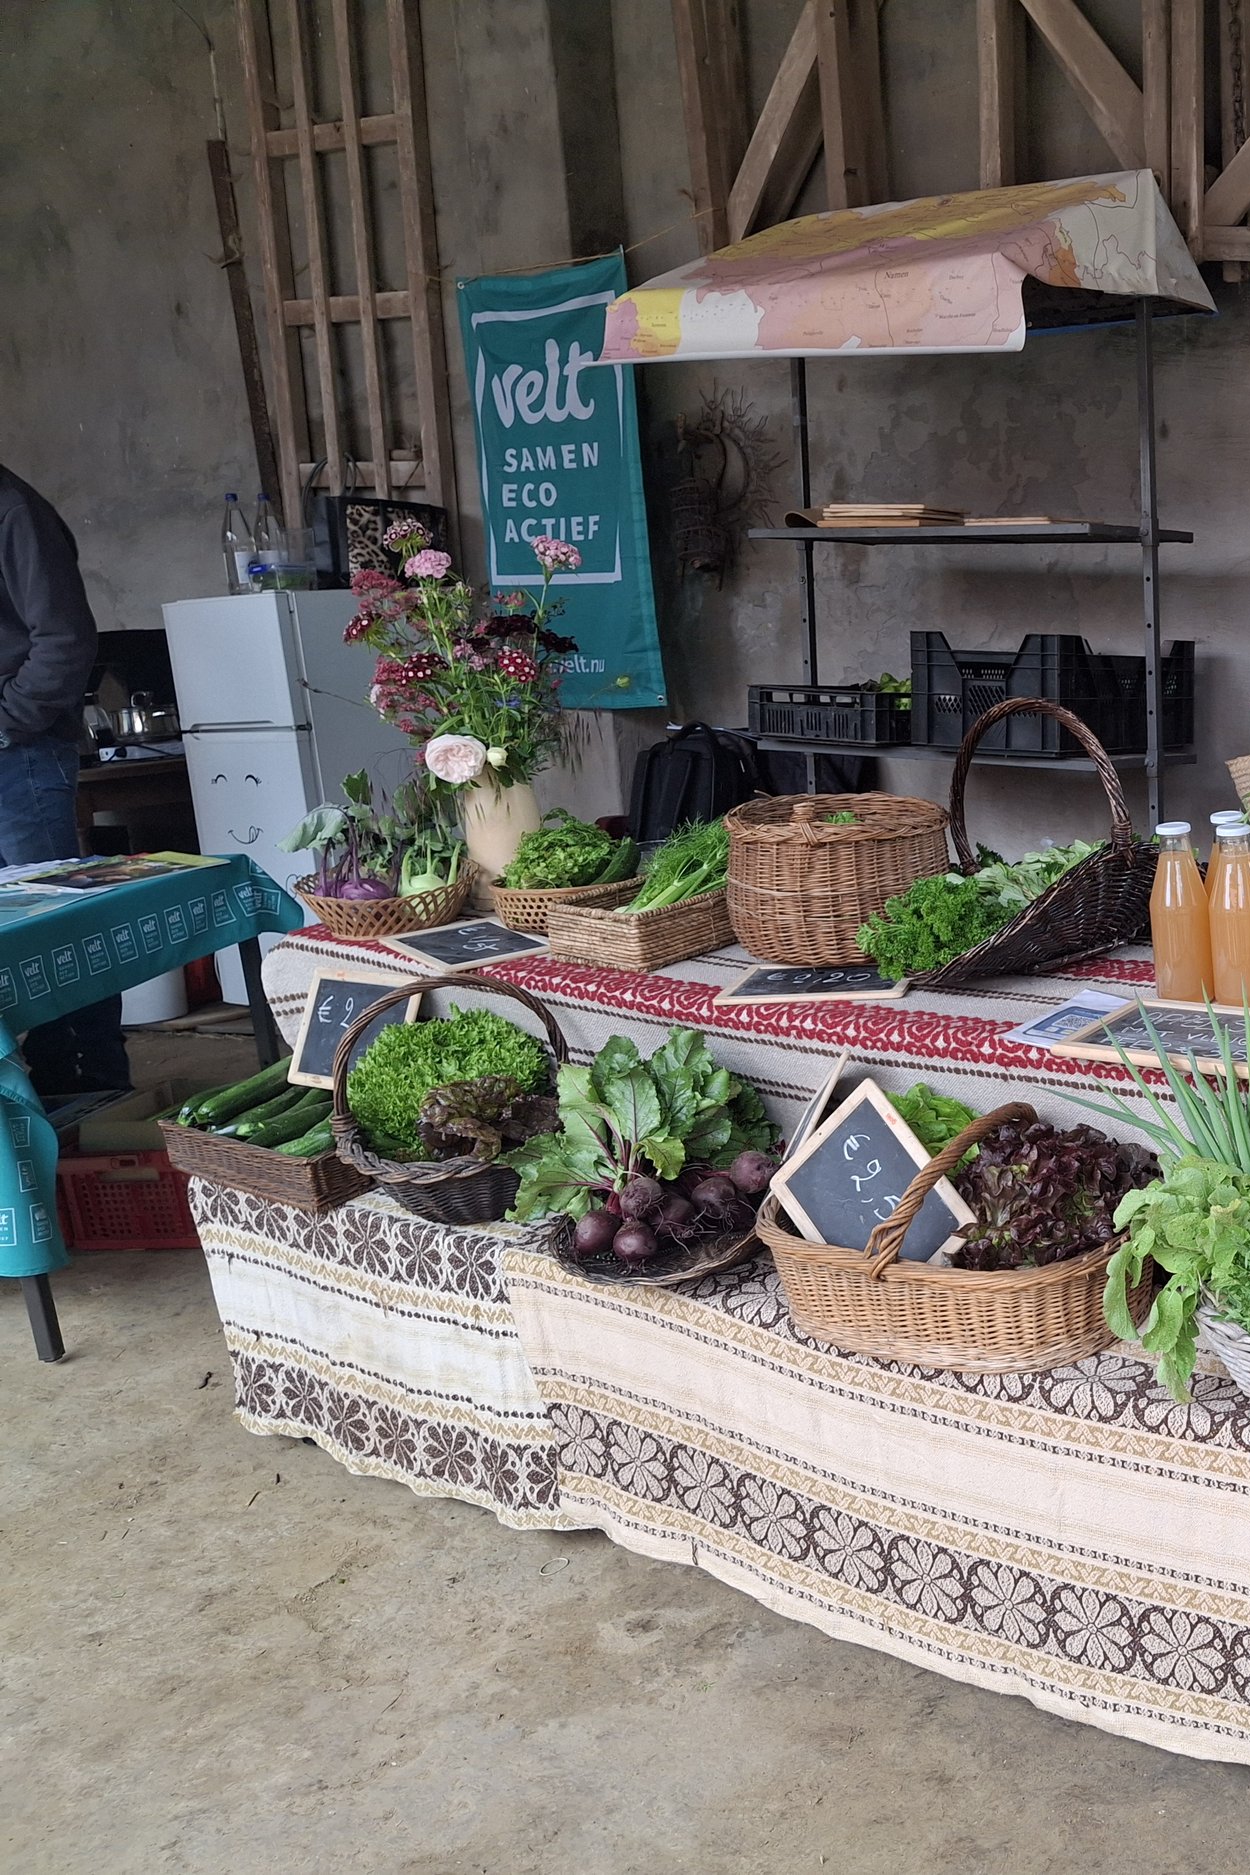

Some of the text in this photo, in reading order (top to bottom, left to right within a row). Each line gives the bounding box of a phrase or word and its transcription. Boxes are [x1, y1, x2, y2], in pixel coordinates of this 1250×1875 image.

[491, 338, 596, 429] velt
[503, 442, 599, 473] SAMEN
[501, 482, 558, 508] ECO
[504, 515, 600, 544] ACTIEF
[317, 995, 334, 1023] €
[843, 1133, 871, 1161] €
